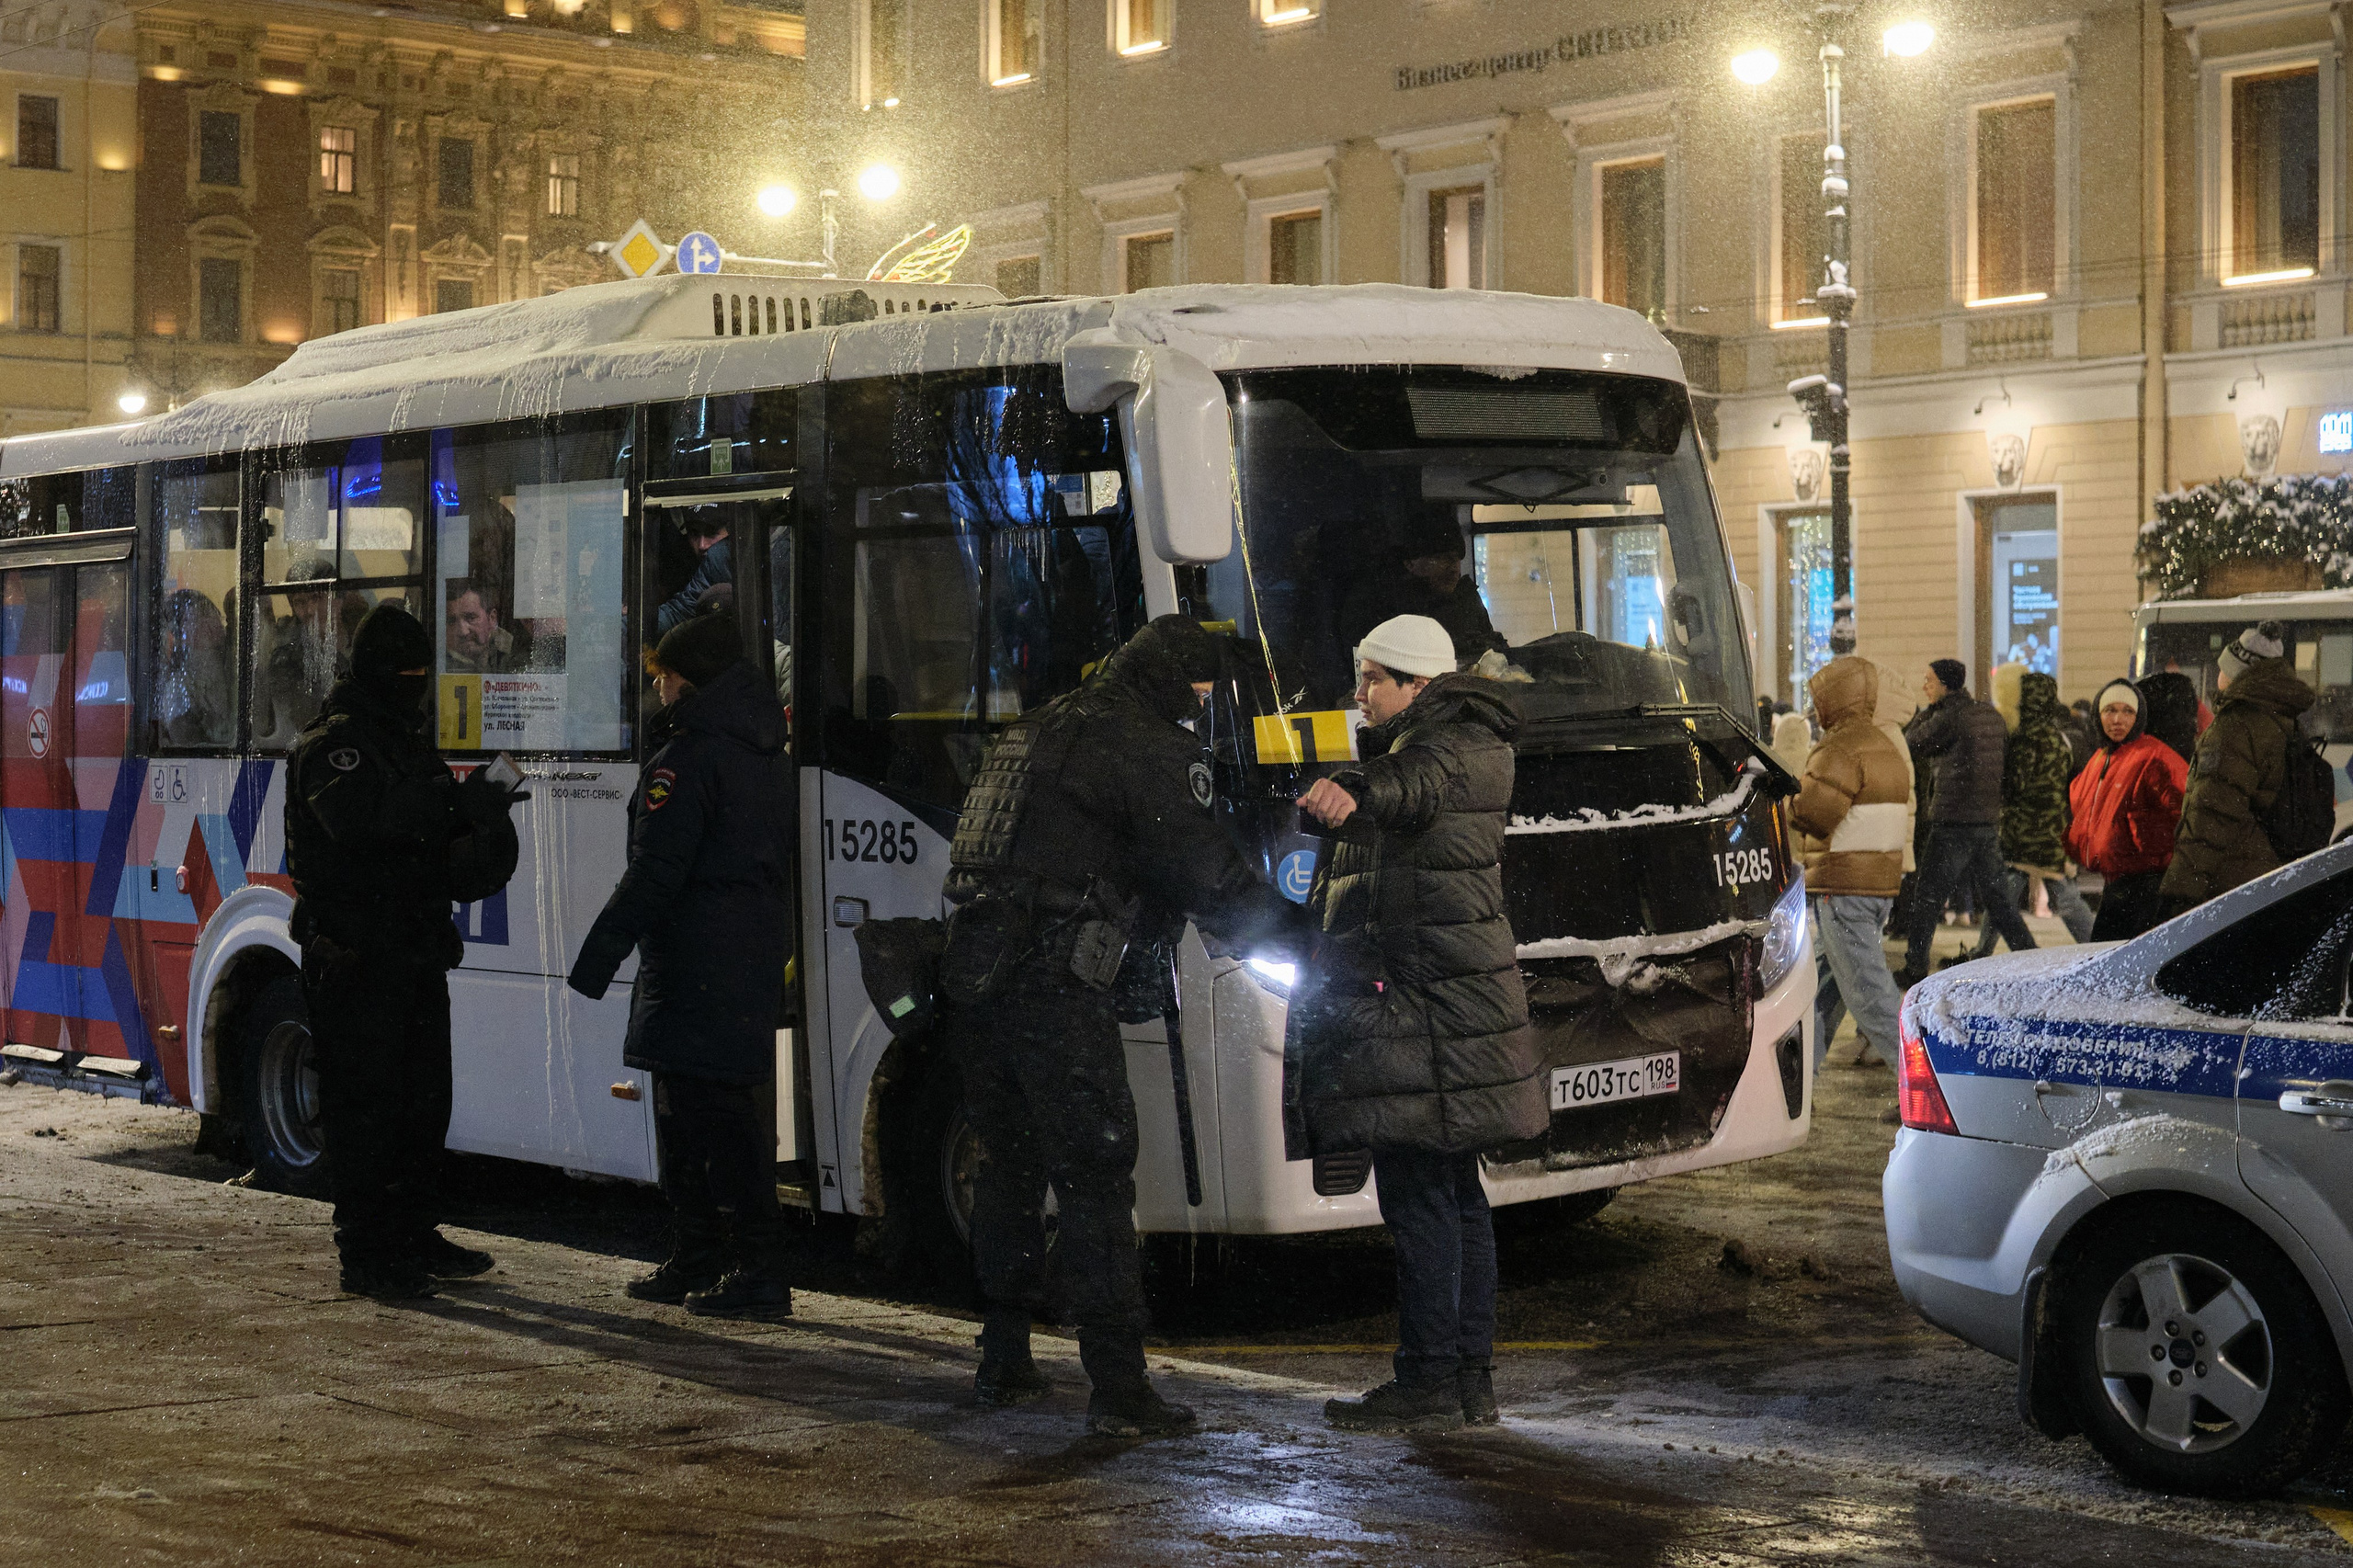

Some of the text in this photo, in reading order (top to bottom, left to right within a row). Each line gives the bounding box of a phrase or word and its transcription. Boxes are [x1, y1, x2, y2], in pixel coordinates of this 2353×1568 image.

[454, 685, 467, 740] 1
[483, 721, 525, 733] ул. ЛЕСНАЯ
[1290, 717, 1318, 763] 1
[824, 819, 918, 865] 15285
[1712, 847, 1773, 887] 15285
[1559, 1057, 1675, 1104] Т603ТС 198
[1976, 1050, 1986, 1065] 8
[1992, 1051, 2035, 1073] (812)
[1650, 1080, 1665, 1091] RUS
